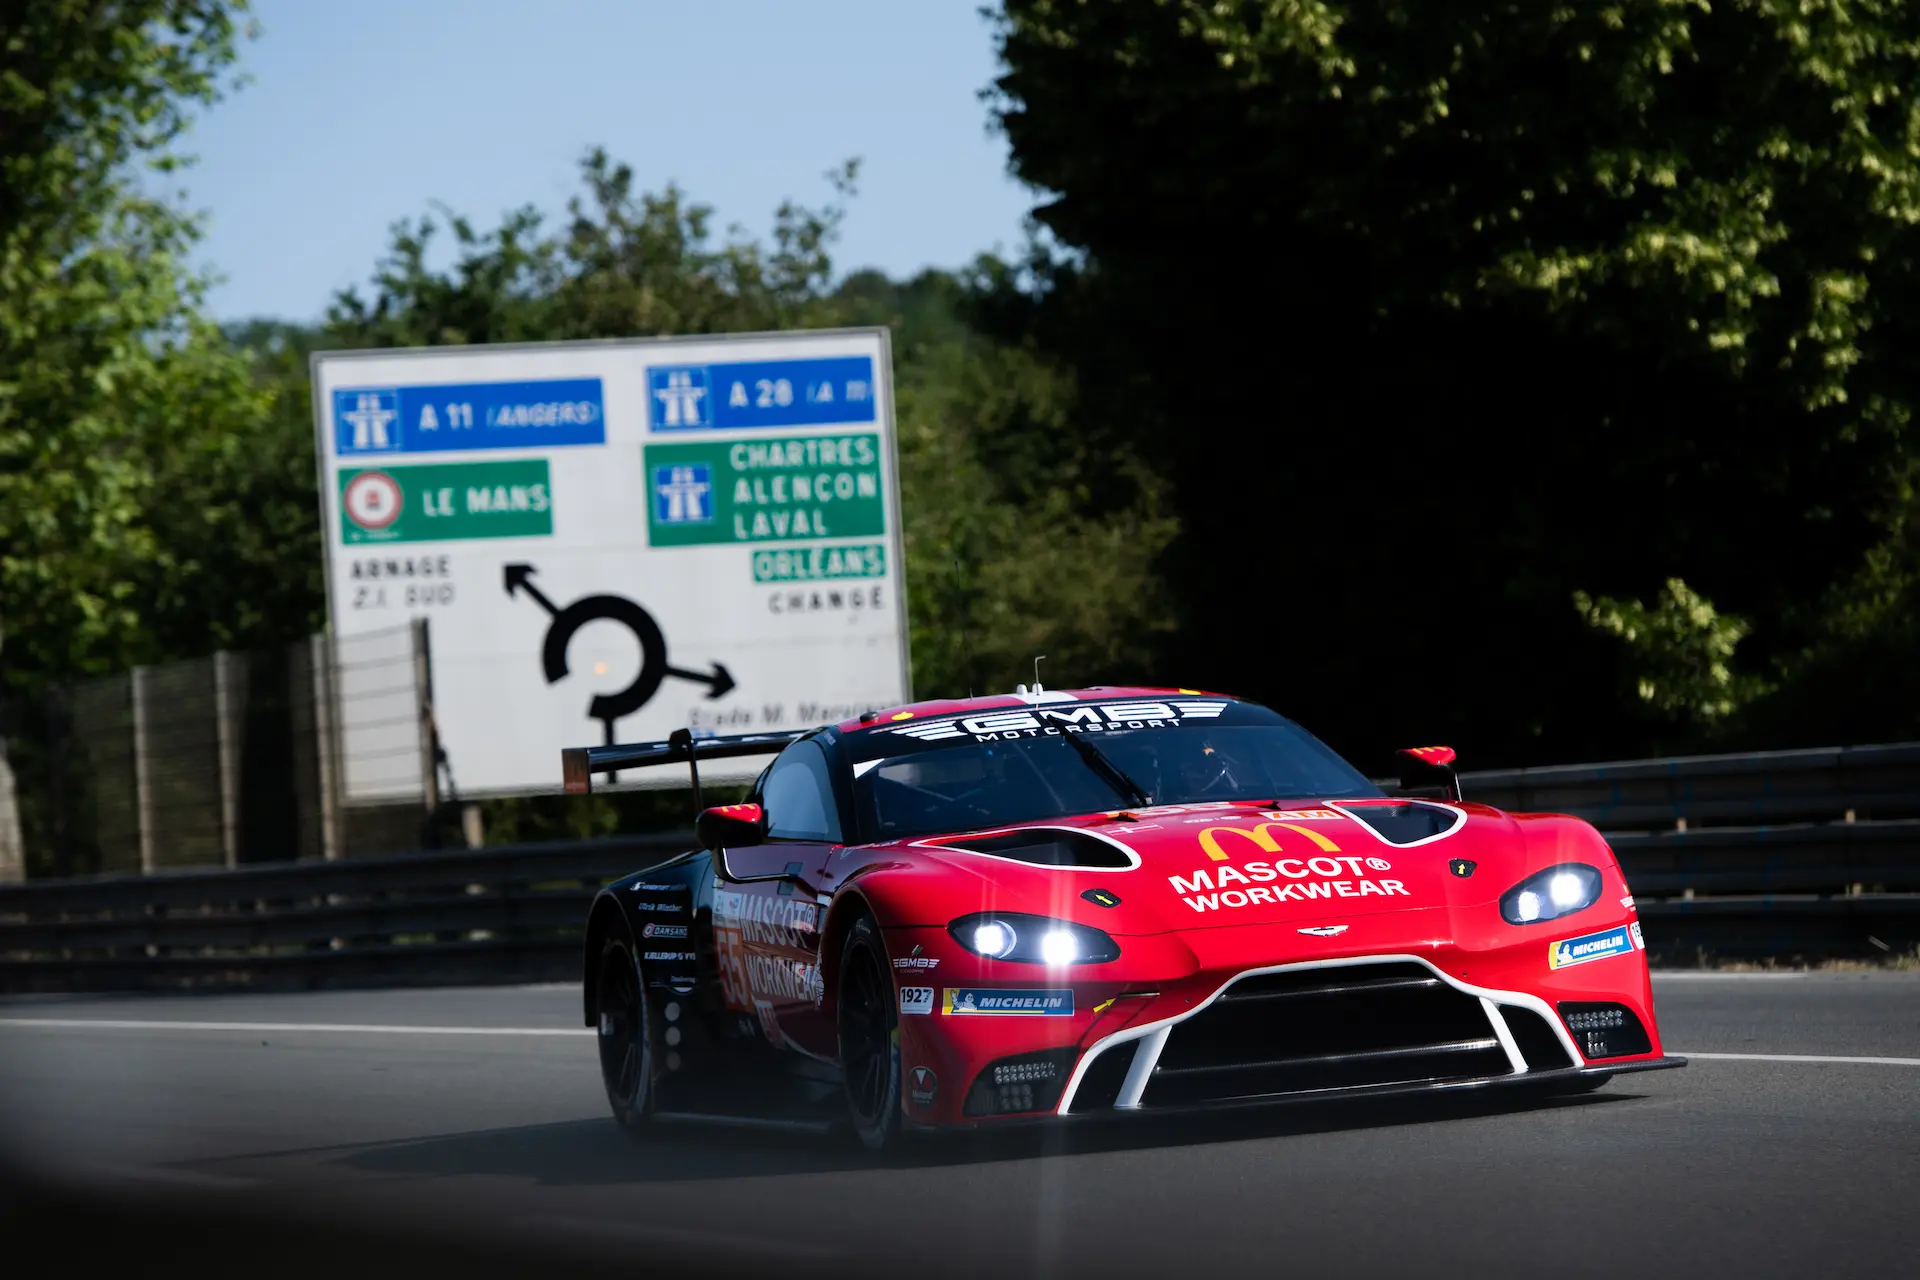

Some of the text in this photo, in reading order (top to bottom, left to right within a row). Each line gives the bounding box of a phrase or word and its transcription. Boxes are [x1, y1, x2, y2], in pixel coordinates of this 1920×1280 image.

[729, 381, 748, 408] A
[419, 403, 439, 431] A
[445, 402, 473, 430] 11
[730, 437, 875, 471] CHARTRES
[422, 484, 549, 517] LE MANS
[734, 472, 877, 504] ALENÇON
[734, 508, 828, 540] LAVAL
[352, 555, 451, 580] ARNAGE
[963, 701, 1181, 734] GMB
[976, 718, 1182, 743] MOTORSPORT
[1182, 879, 1410, 912] WORKWEAR
[1573, 934, 1624, 956] MICHELIN
[716, 929, 749, 1006] 55
[901, 988, 932, 1004] 1927
[980, 997, 1062, 1008] MICHELIN
